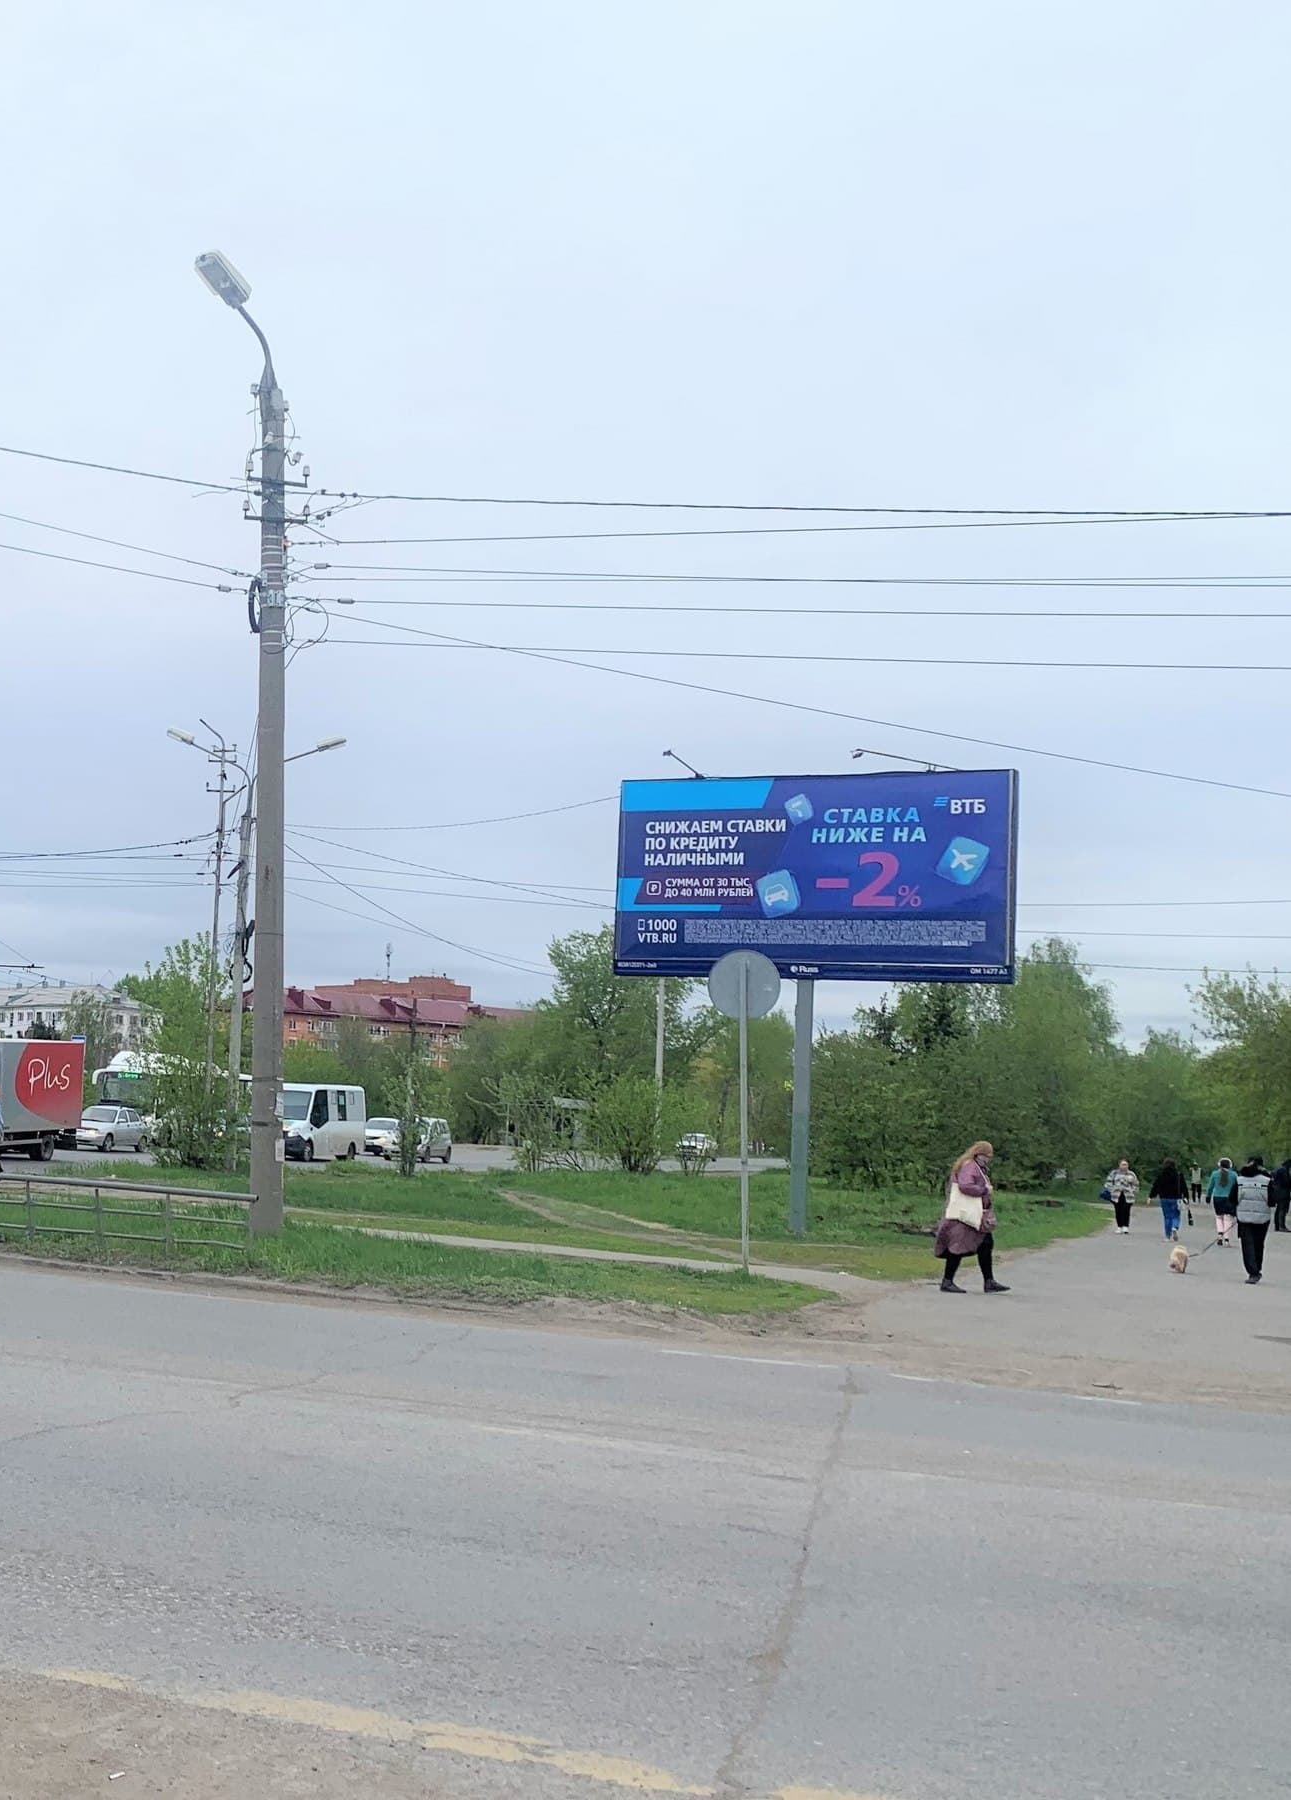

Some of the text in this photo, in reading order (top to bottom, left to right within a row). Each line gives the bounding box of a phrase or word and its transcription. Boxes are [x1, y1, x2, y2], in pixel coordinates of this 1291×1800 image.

[950, 799, 986, 815] ВТБ
[823, 806, 921, 824] СТАВКА
[645, 819, 787, 834] СНИЖАЕМ СТАВКИ
[811, 826, 927, 844] НИЖЕ НА
[645, 836, 739, 852] ПО КРЕДИТУ
[644, 852, 745, 866] НАЛИЧНЫМИ
[665, 878, 701, 887] СУММА
[702, 878, 715, 887] ОТ
[716, 878, 729, 887] 30
[664, 886, 754, 898] ДО 40 МЛН РУБЛЕЙ
[647, 919, 677, 931] 1000
[638, 933, 677, 944] VTB.RU
[27, 1056, 71, 1096] Plus
